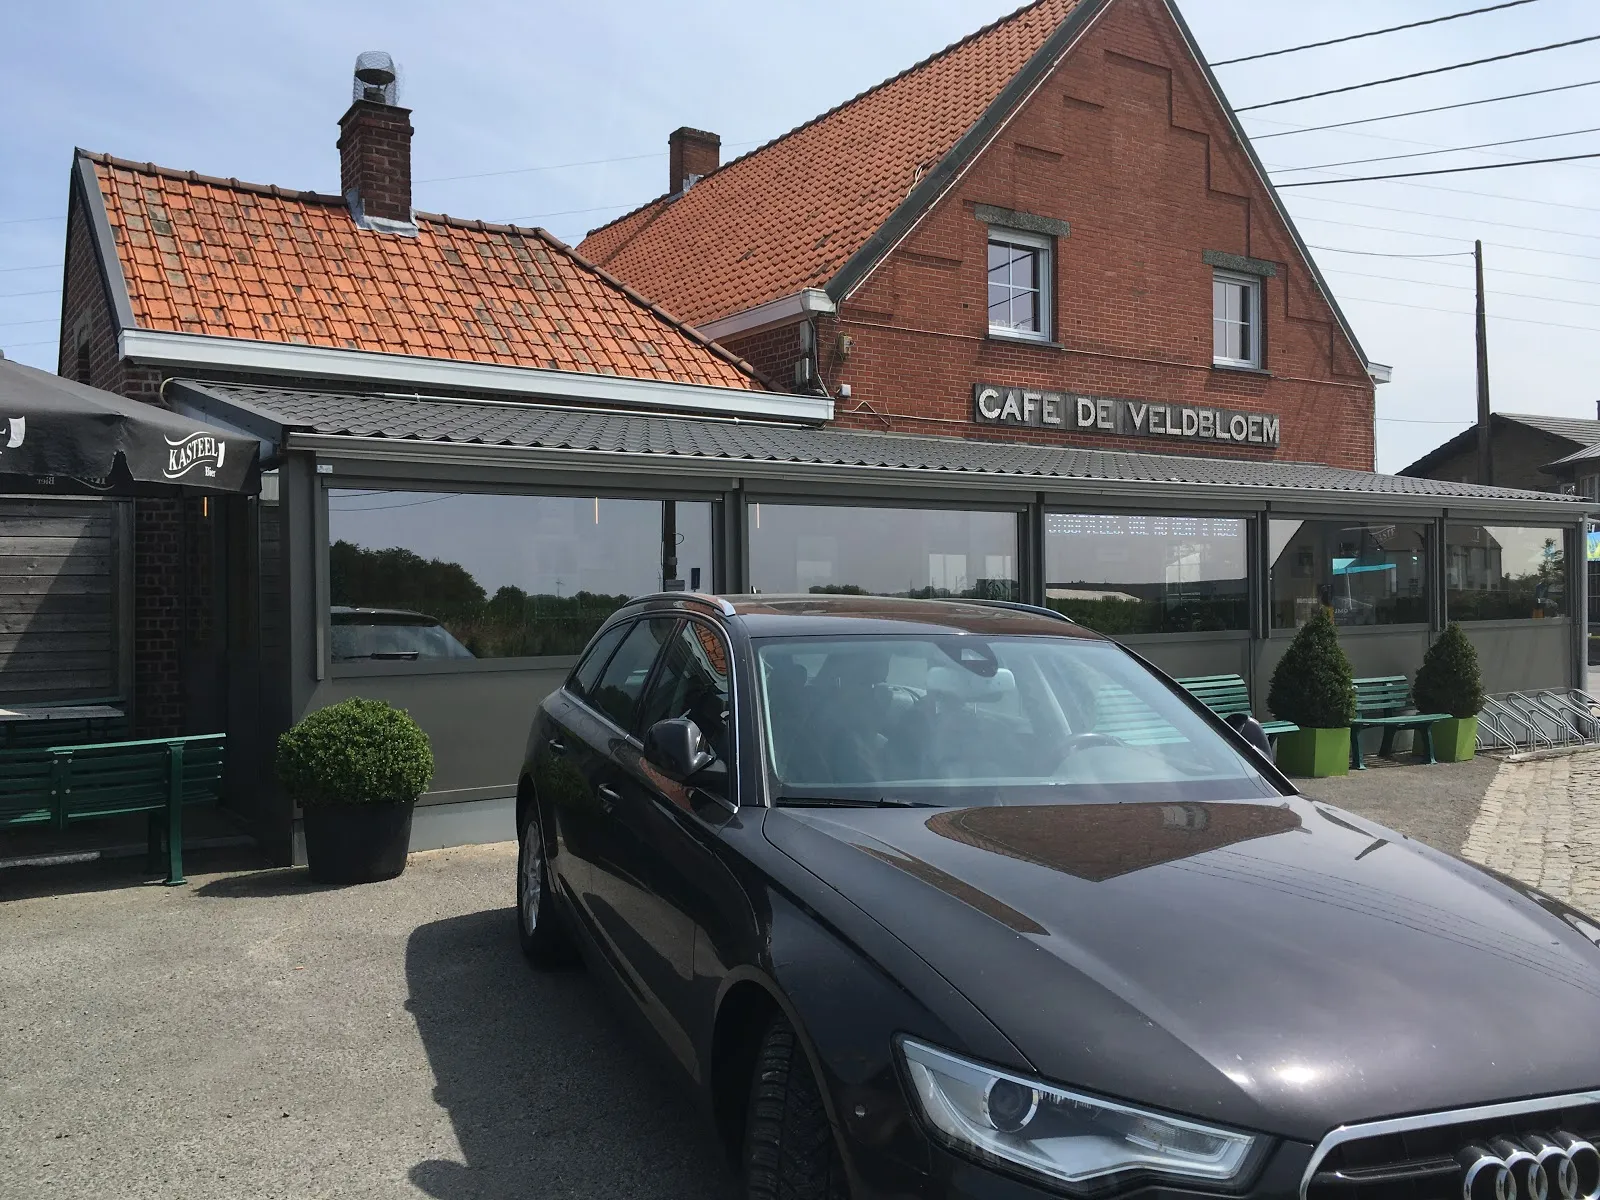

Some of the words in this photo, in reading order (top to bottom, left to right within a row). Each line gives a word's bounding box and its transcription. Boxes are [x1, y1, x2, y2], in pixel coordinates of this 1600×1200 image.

[978, 388, 1061, 425] CAFE
[1076, 398, 1115, 430] DE
[1127, 401, 1281, 444] VELDBLOEM
[168, 437, 219, 471] KASTEEL
